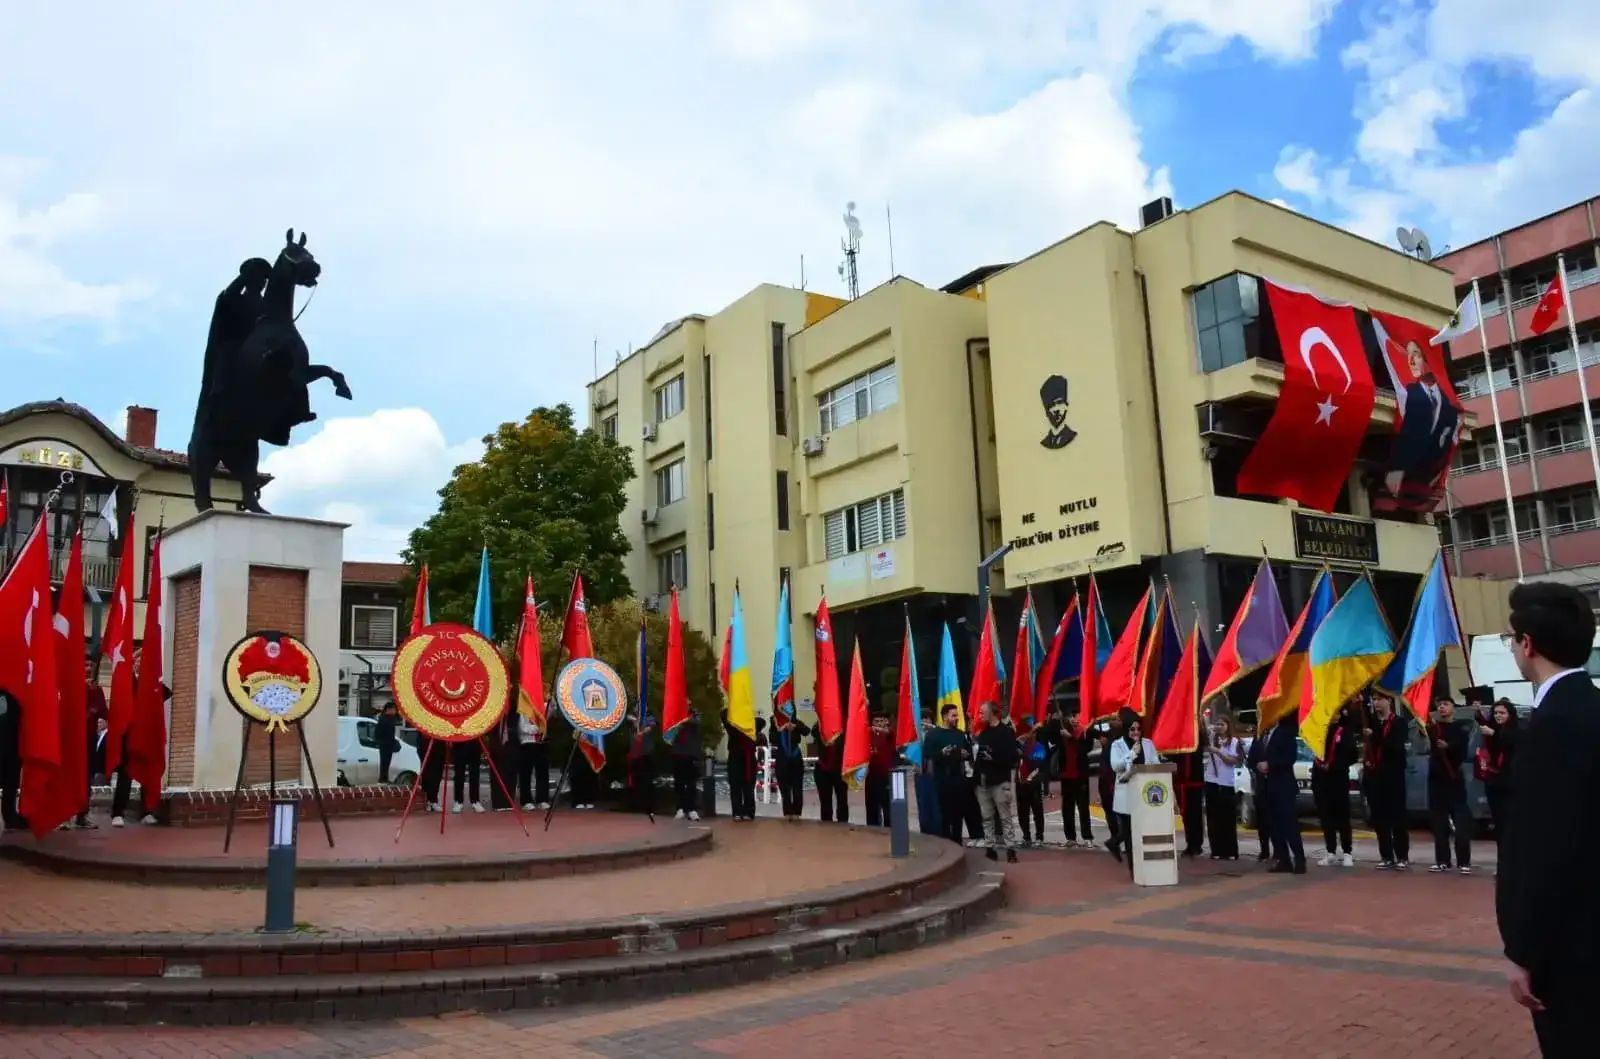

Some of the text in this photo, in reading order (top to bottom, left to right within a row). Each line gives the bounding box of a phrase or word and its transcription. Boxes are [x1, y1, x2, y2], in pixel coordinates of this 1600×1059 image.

[1021, 497, 1097, 525] NE MUTLU
[1059, 520, 1100, 540] DİYENE
